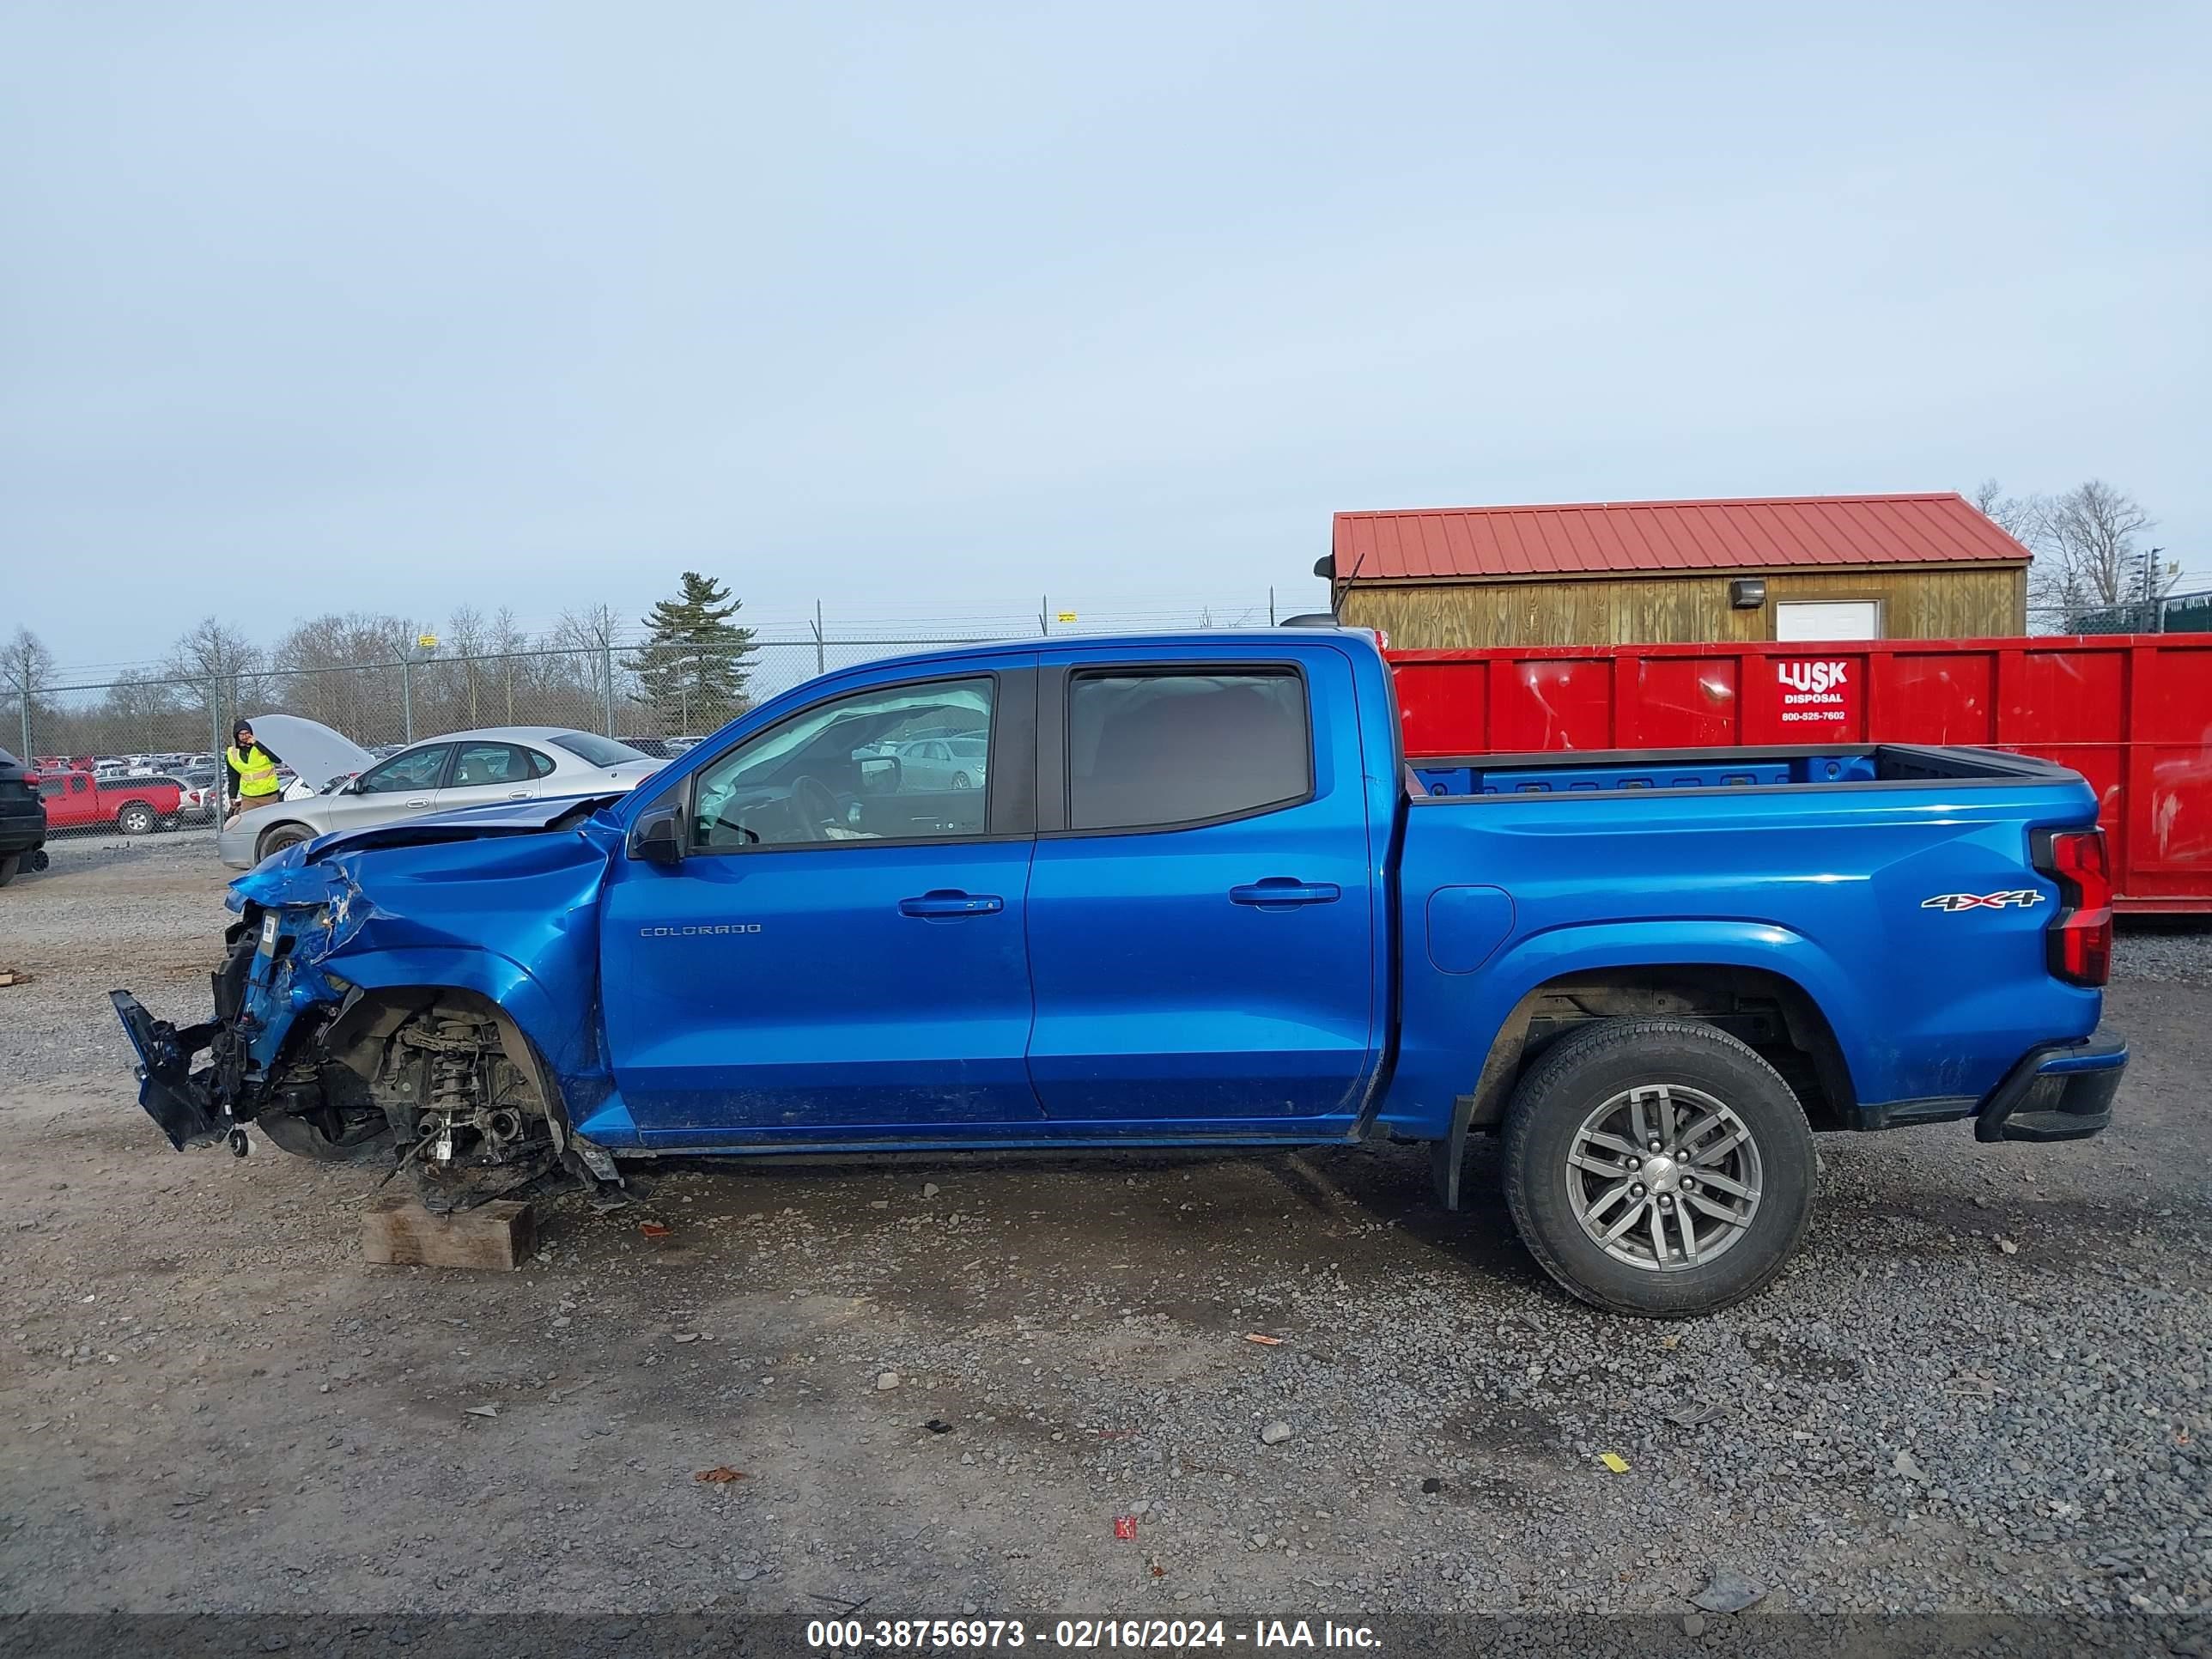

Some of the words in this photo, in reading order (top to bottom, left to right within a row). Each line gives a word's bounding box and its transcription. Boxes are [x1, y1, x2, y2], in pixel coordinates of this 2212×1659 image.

[1778, 662, 1848, 693] LUSK
[1784, 694, 1844, 704] DISPOSAL
[1782, 711, 1845, 721] 800-525-7602
[641, 924, 762, 937] COLORADO
